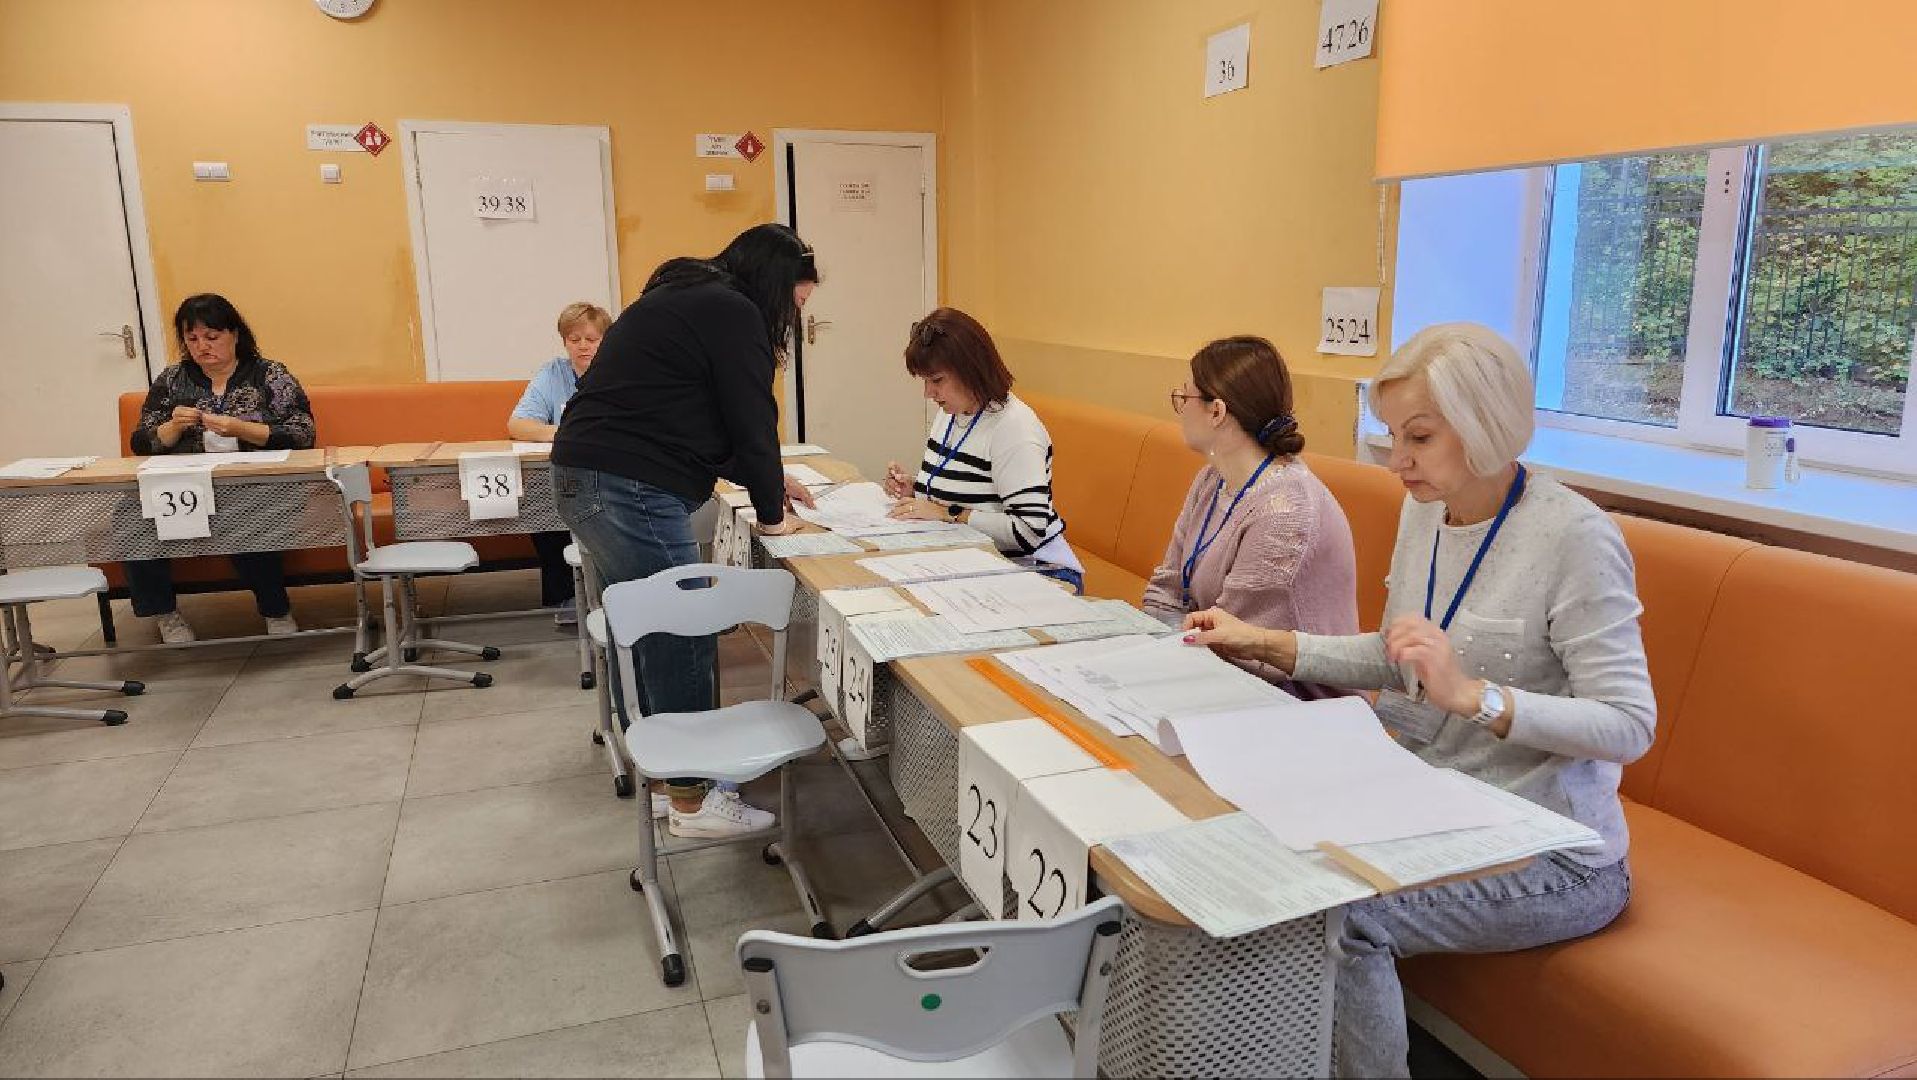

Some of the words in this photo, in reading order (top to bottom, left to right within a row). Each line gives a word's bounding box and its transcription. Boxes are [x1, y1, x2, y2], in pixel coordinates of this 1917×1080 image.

[1218, 56, 1236, 84] 36
[159, 490, 198, 517] 39
[477, 473, 510, 499] 38
[848, 655, 866, 703] 24
[967, 782, 998, 859] 23
[1026, 847, 1067, 919] 22
